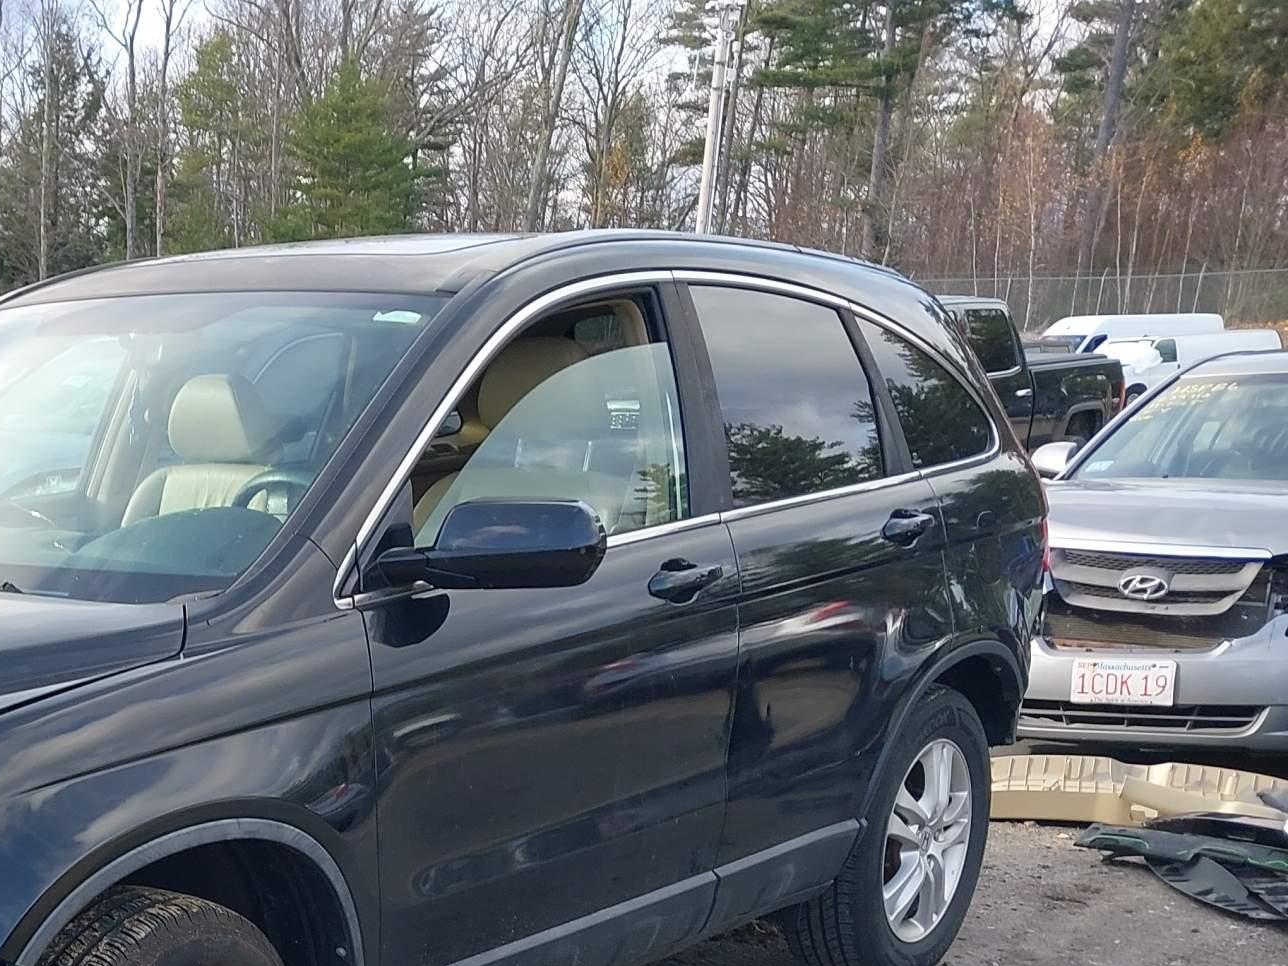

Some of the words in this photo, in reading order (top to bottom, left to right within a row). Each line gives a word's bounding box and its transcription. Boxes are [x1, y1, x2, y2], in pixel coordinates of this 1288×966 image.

[1095, 661, 1152, 672] Massachusetts
[1076, 673, 1132, 696] 1CDK
[1140, 674, 1168, 698] 19
